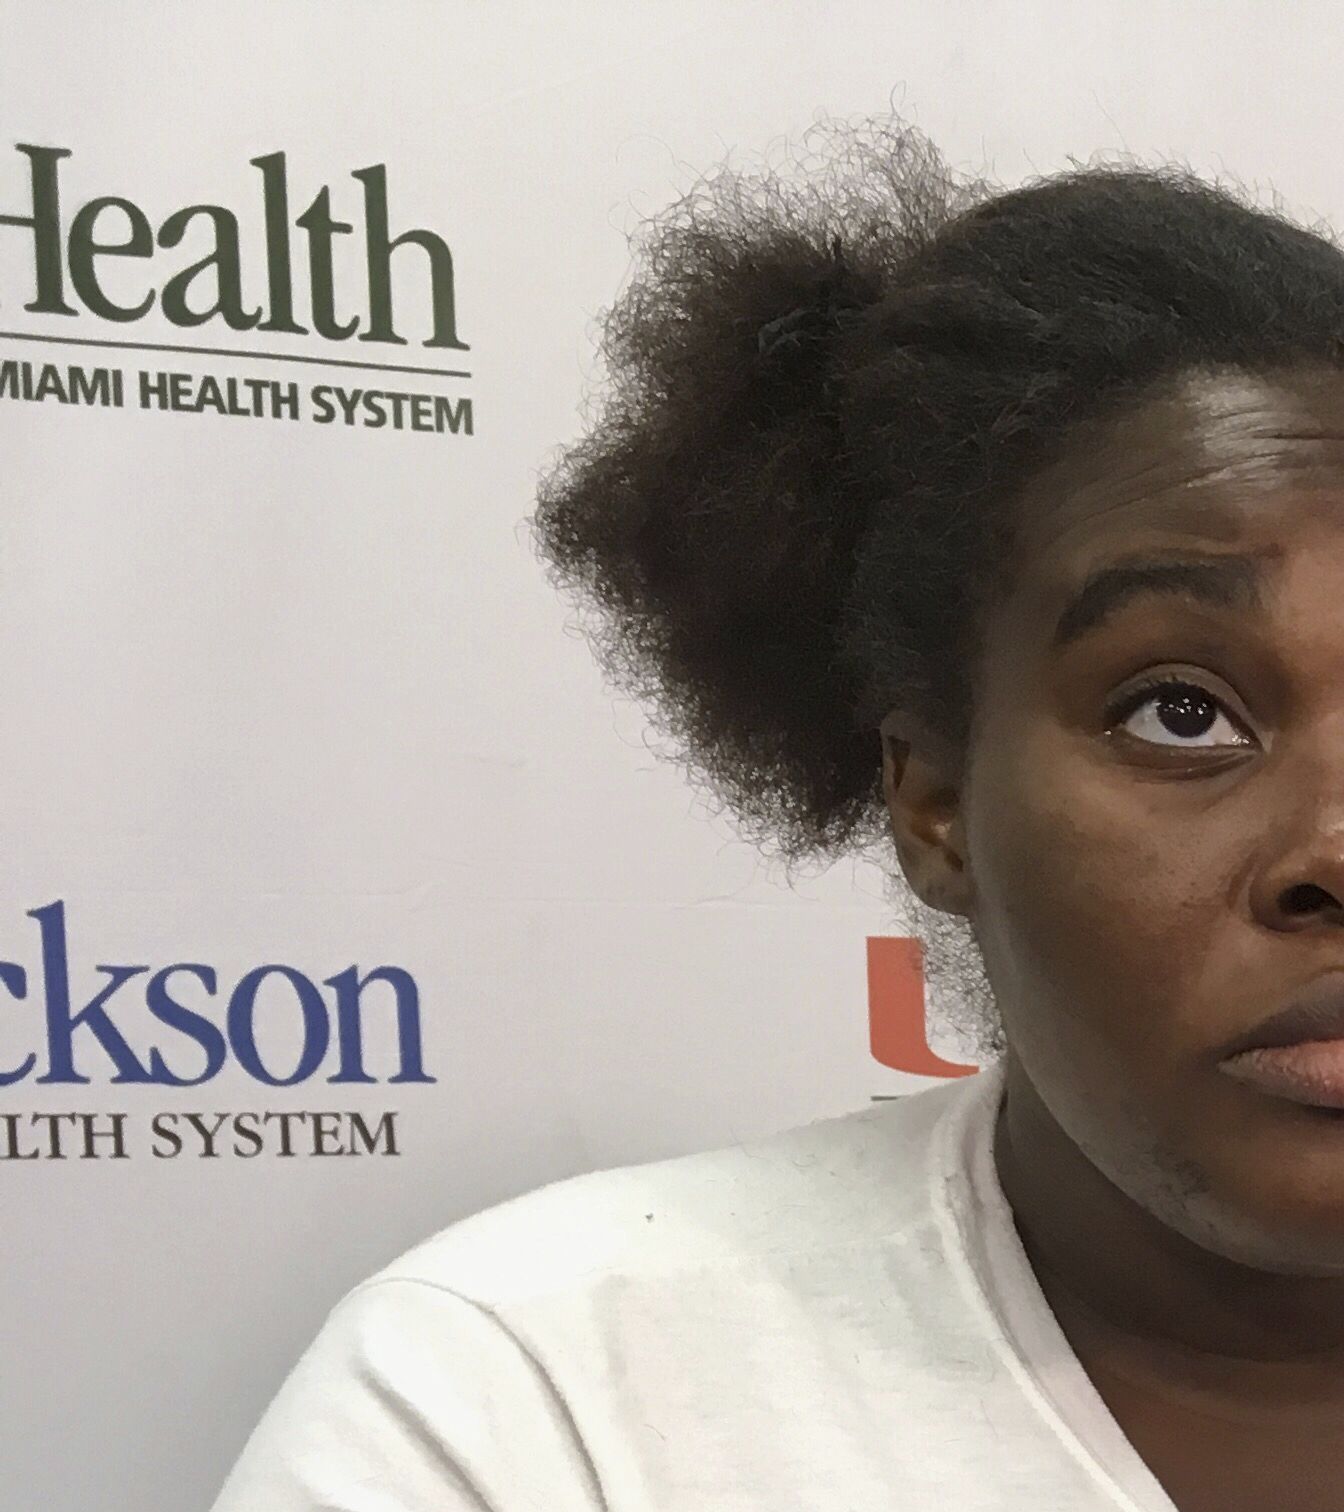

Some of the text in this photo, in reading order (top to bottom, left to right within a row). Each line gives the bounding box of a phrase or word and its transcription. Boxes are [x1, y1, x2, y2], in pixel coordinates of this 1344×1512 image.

[138, 370, 299, 421] HEALTH
[311, 385, 475, 436] SYSTEM
[150, 1110, 400, 1160] SYSTEM
